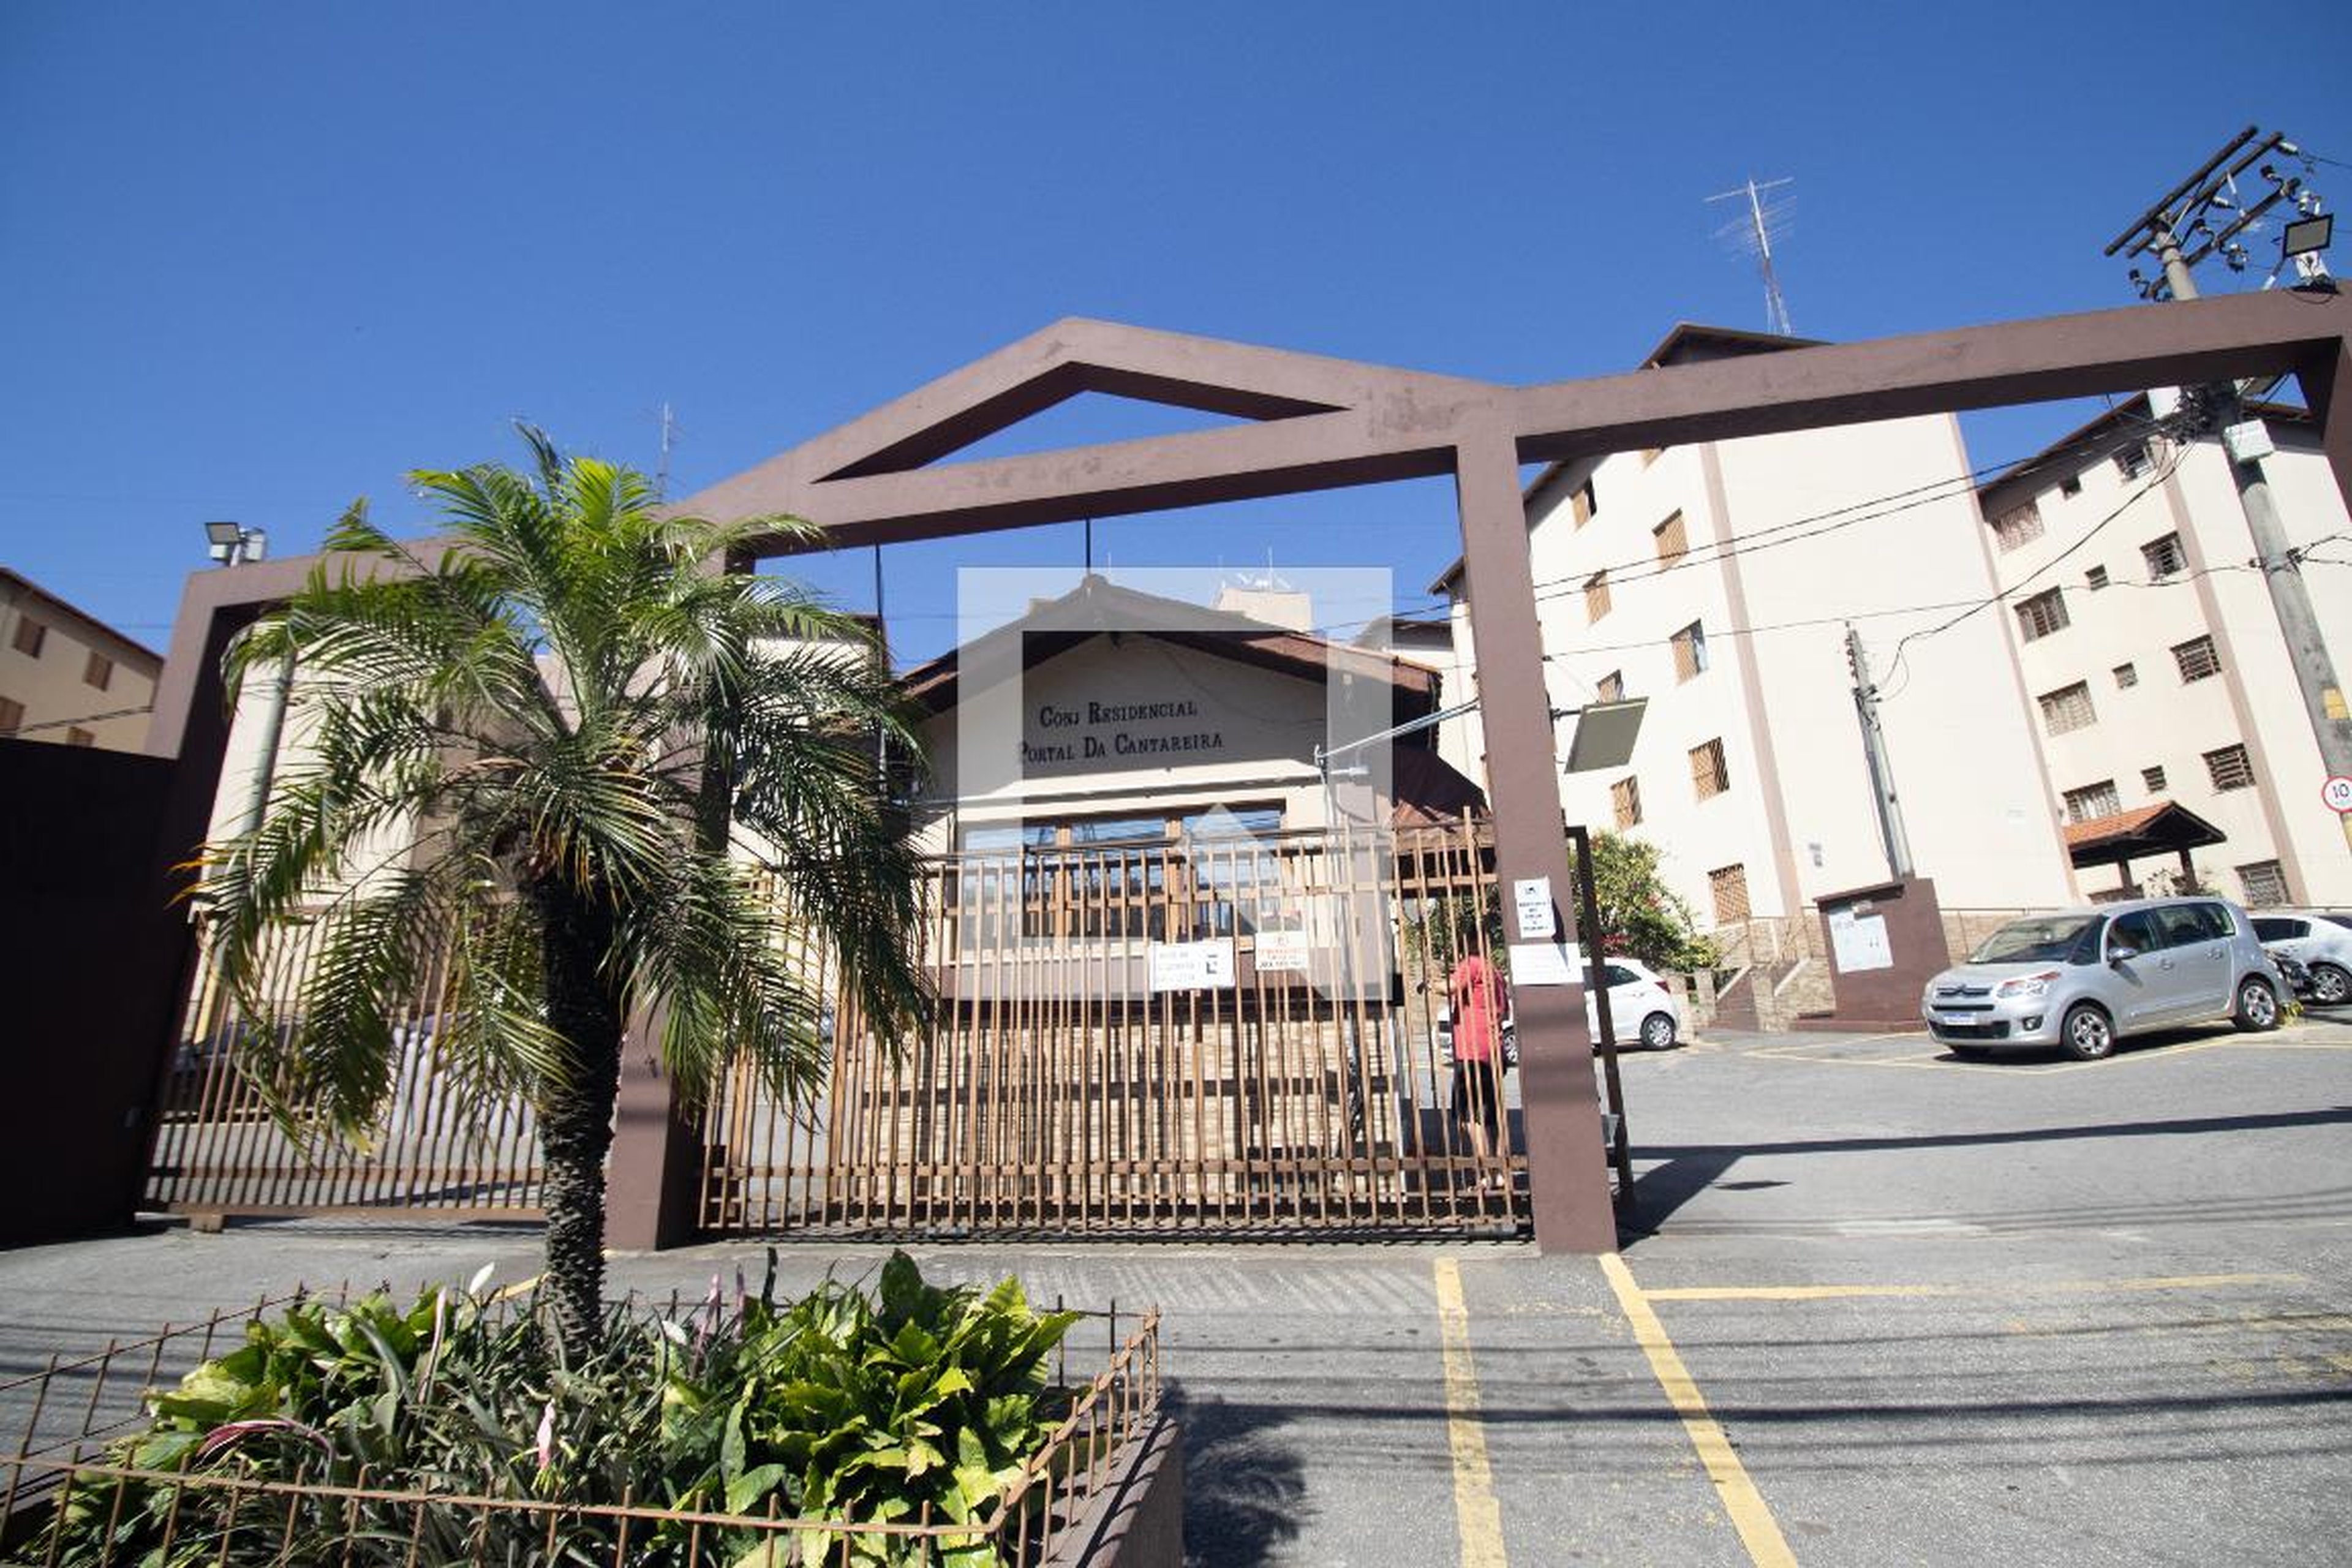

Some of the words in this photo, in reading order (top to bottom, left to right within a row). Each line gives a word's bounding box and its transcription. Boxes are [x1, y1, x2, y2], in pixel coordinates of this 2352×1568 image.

[1040, 706, 1079, 728] CONJ
[1088, 701, 1197, 725] RESIDENCIAL
[1084, 736, 1106, 758] DA
[1115, 734, 1224, 755] CANTAREIRA
